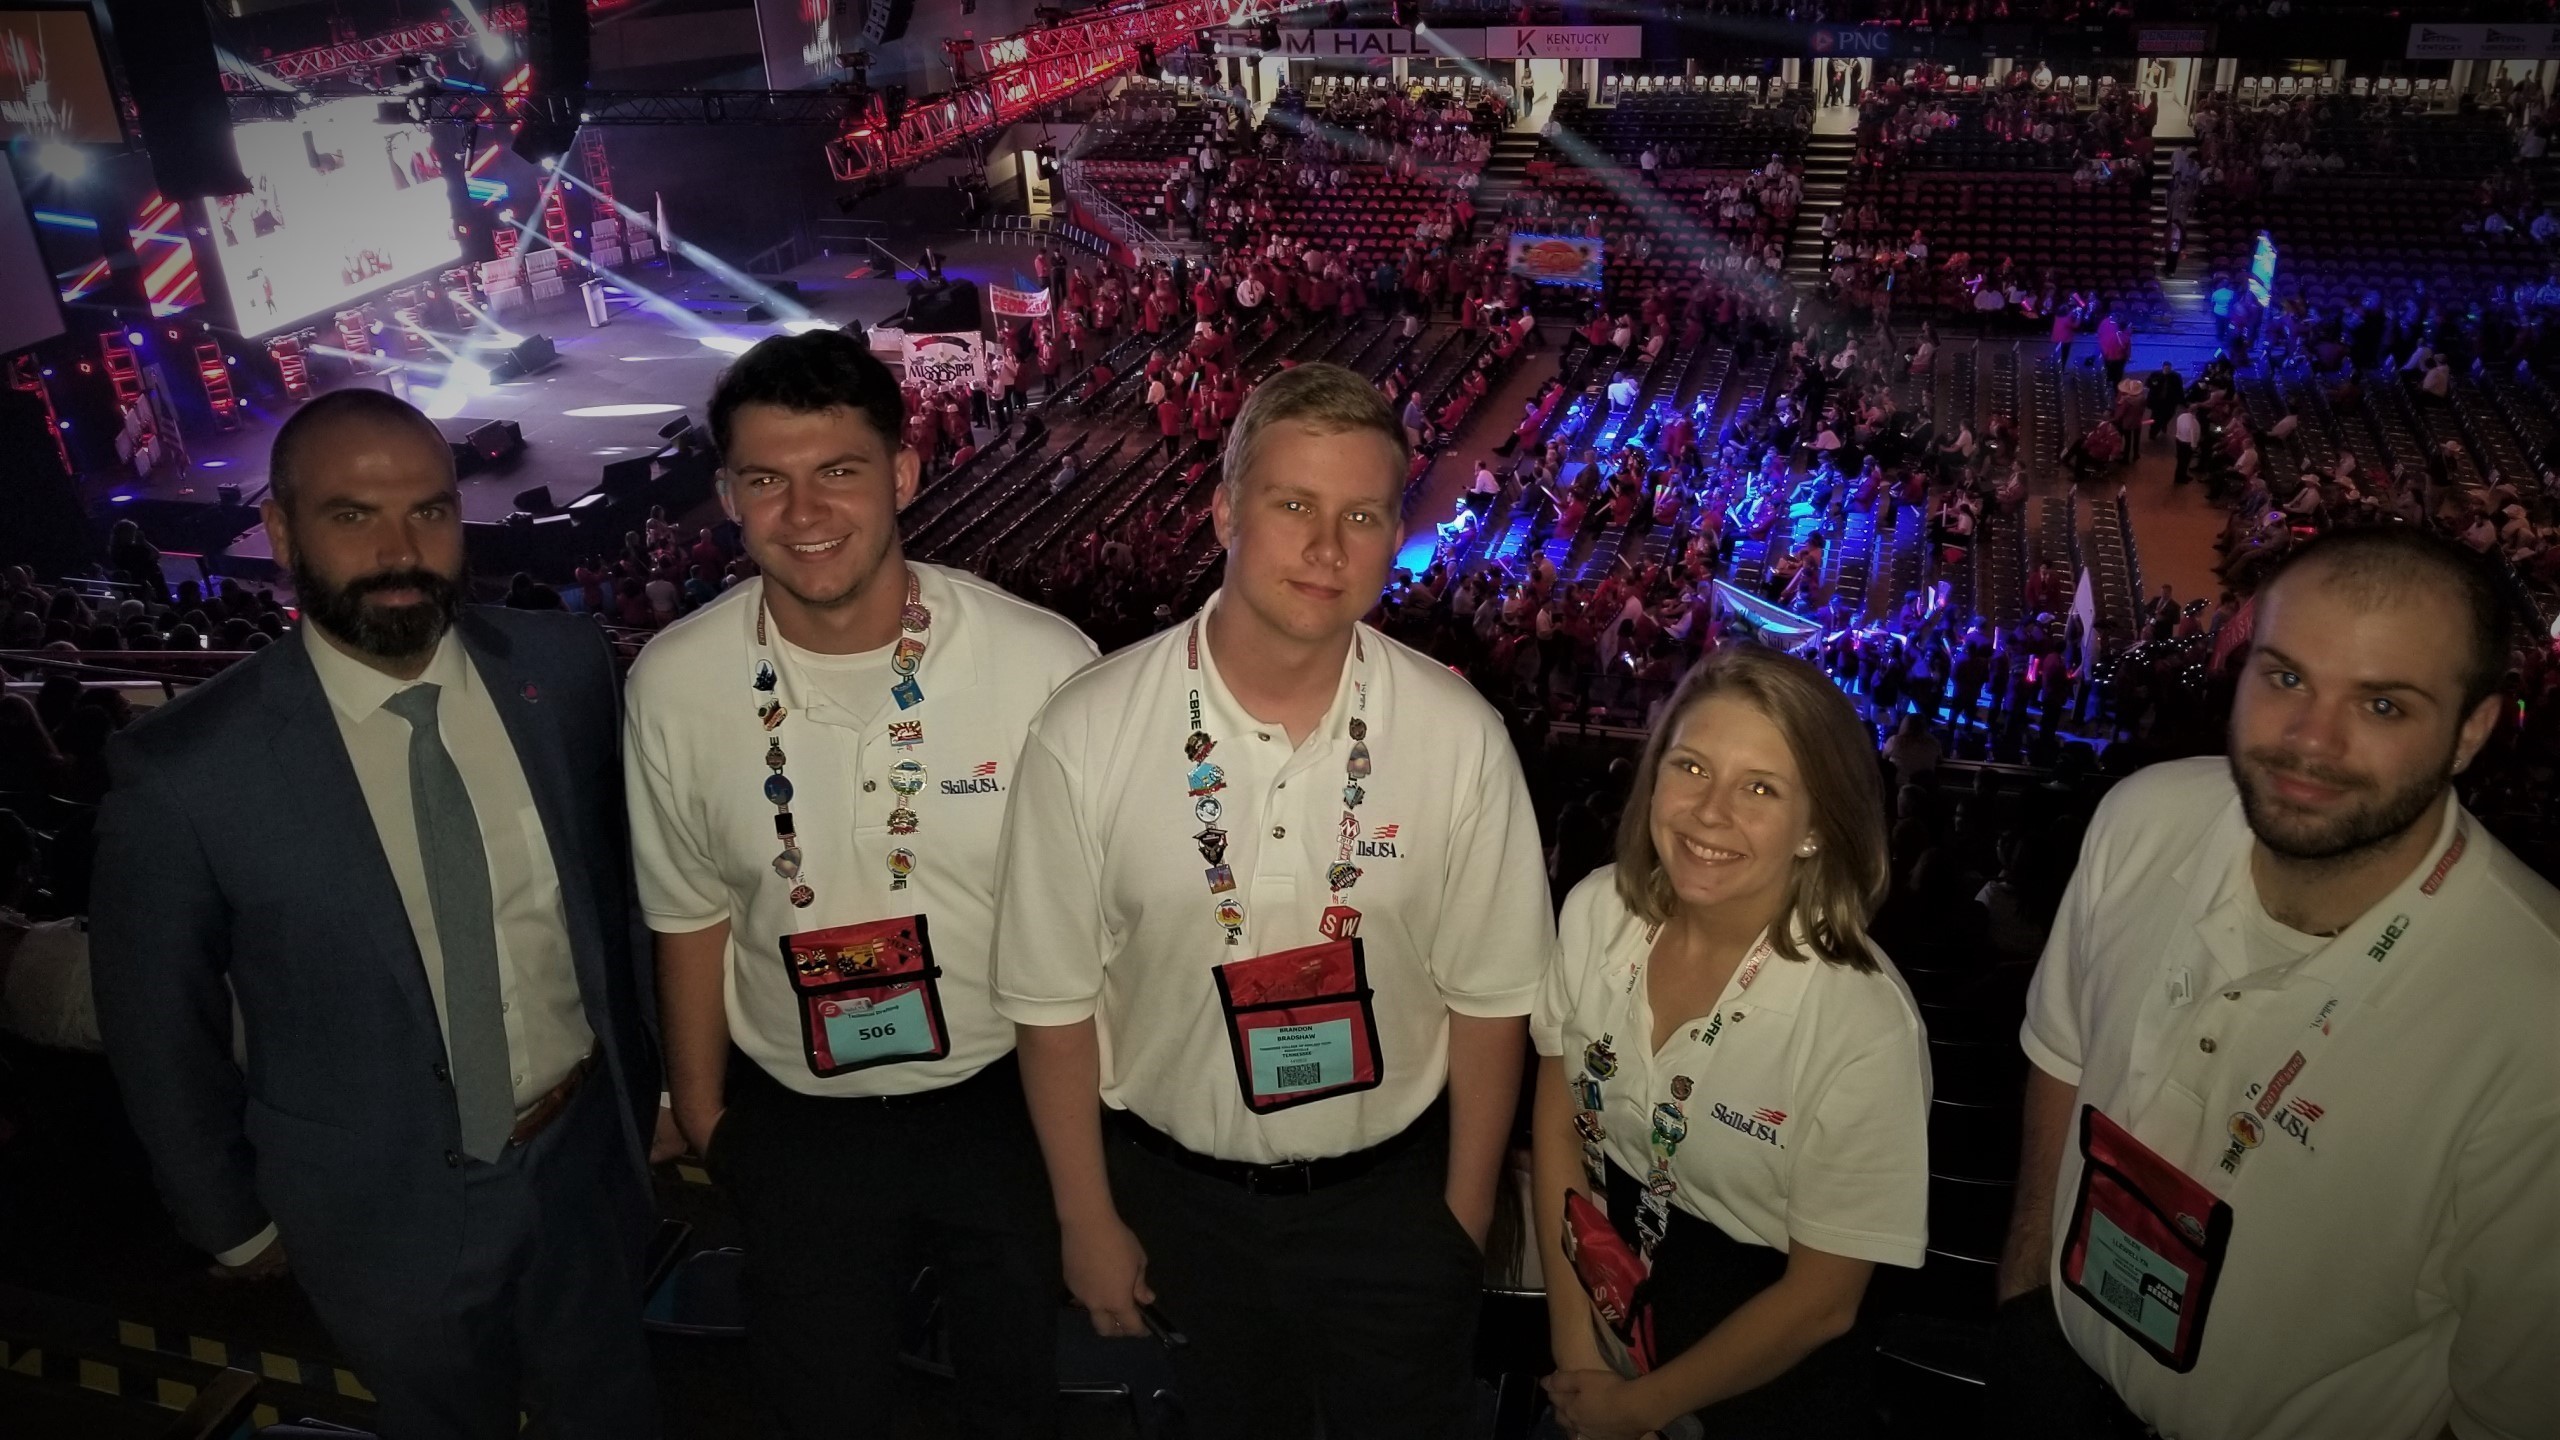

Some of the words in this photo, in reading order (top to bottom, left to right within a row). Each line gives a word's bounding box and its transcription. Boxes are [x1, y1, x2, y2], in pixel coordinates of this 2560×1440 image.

[1334, 33, 1430, 54] HALL
[1546, 33, 1610, 44] KENTUCKY
[1838, 31, 1889, 51] PNC
[1189, 689, 1202, 731] CBRE
[2366, 912, 2411, 963] CBRE
[859, 1022, 896, 1041] 506
[1277, 1033, 1316, 1041] BRADSHAW
[1279, 1025, 1313, 1033] BRANDON
[2147, 1284, 2179, 1311] SEEKER
[2155, 1283, 2173, 1299] JOB
